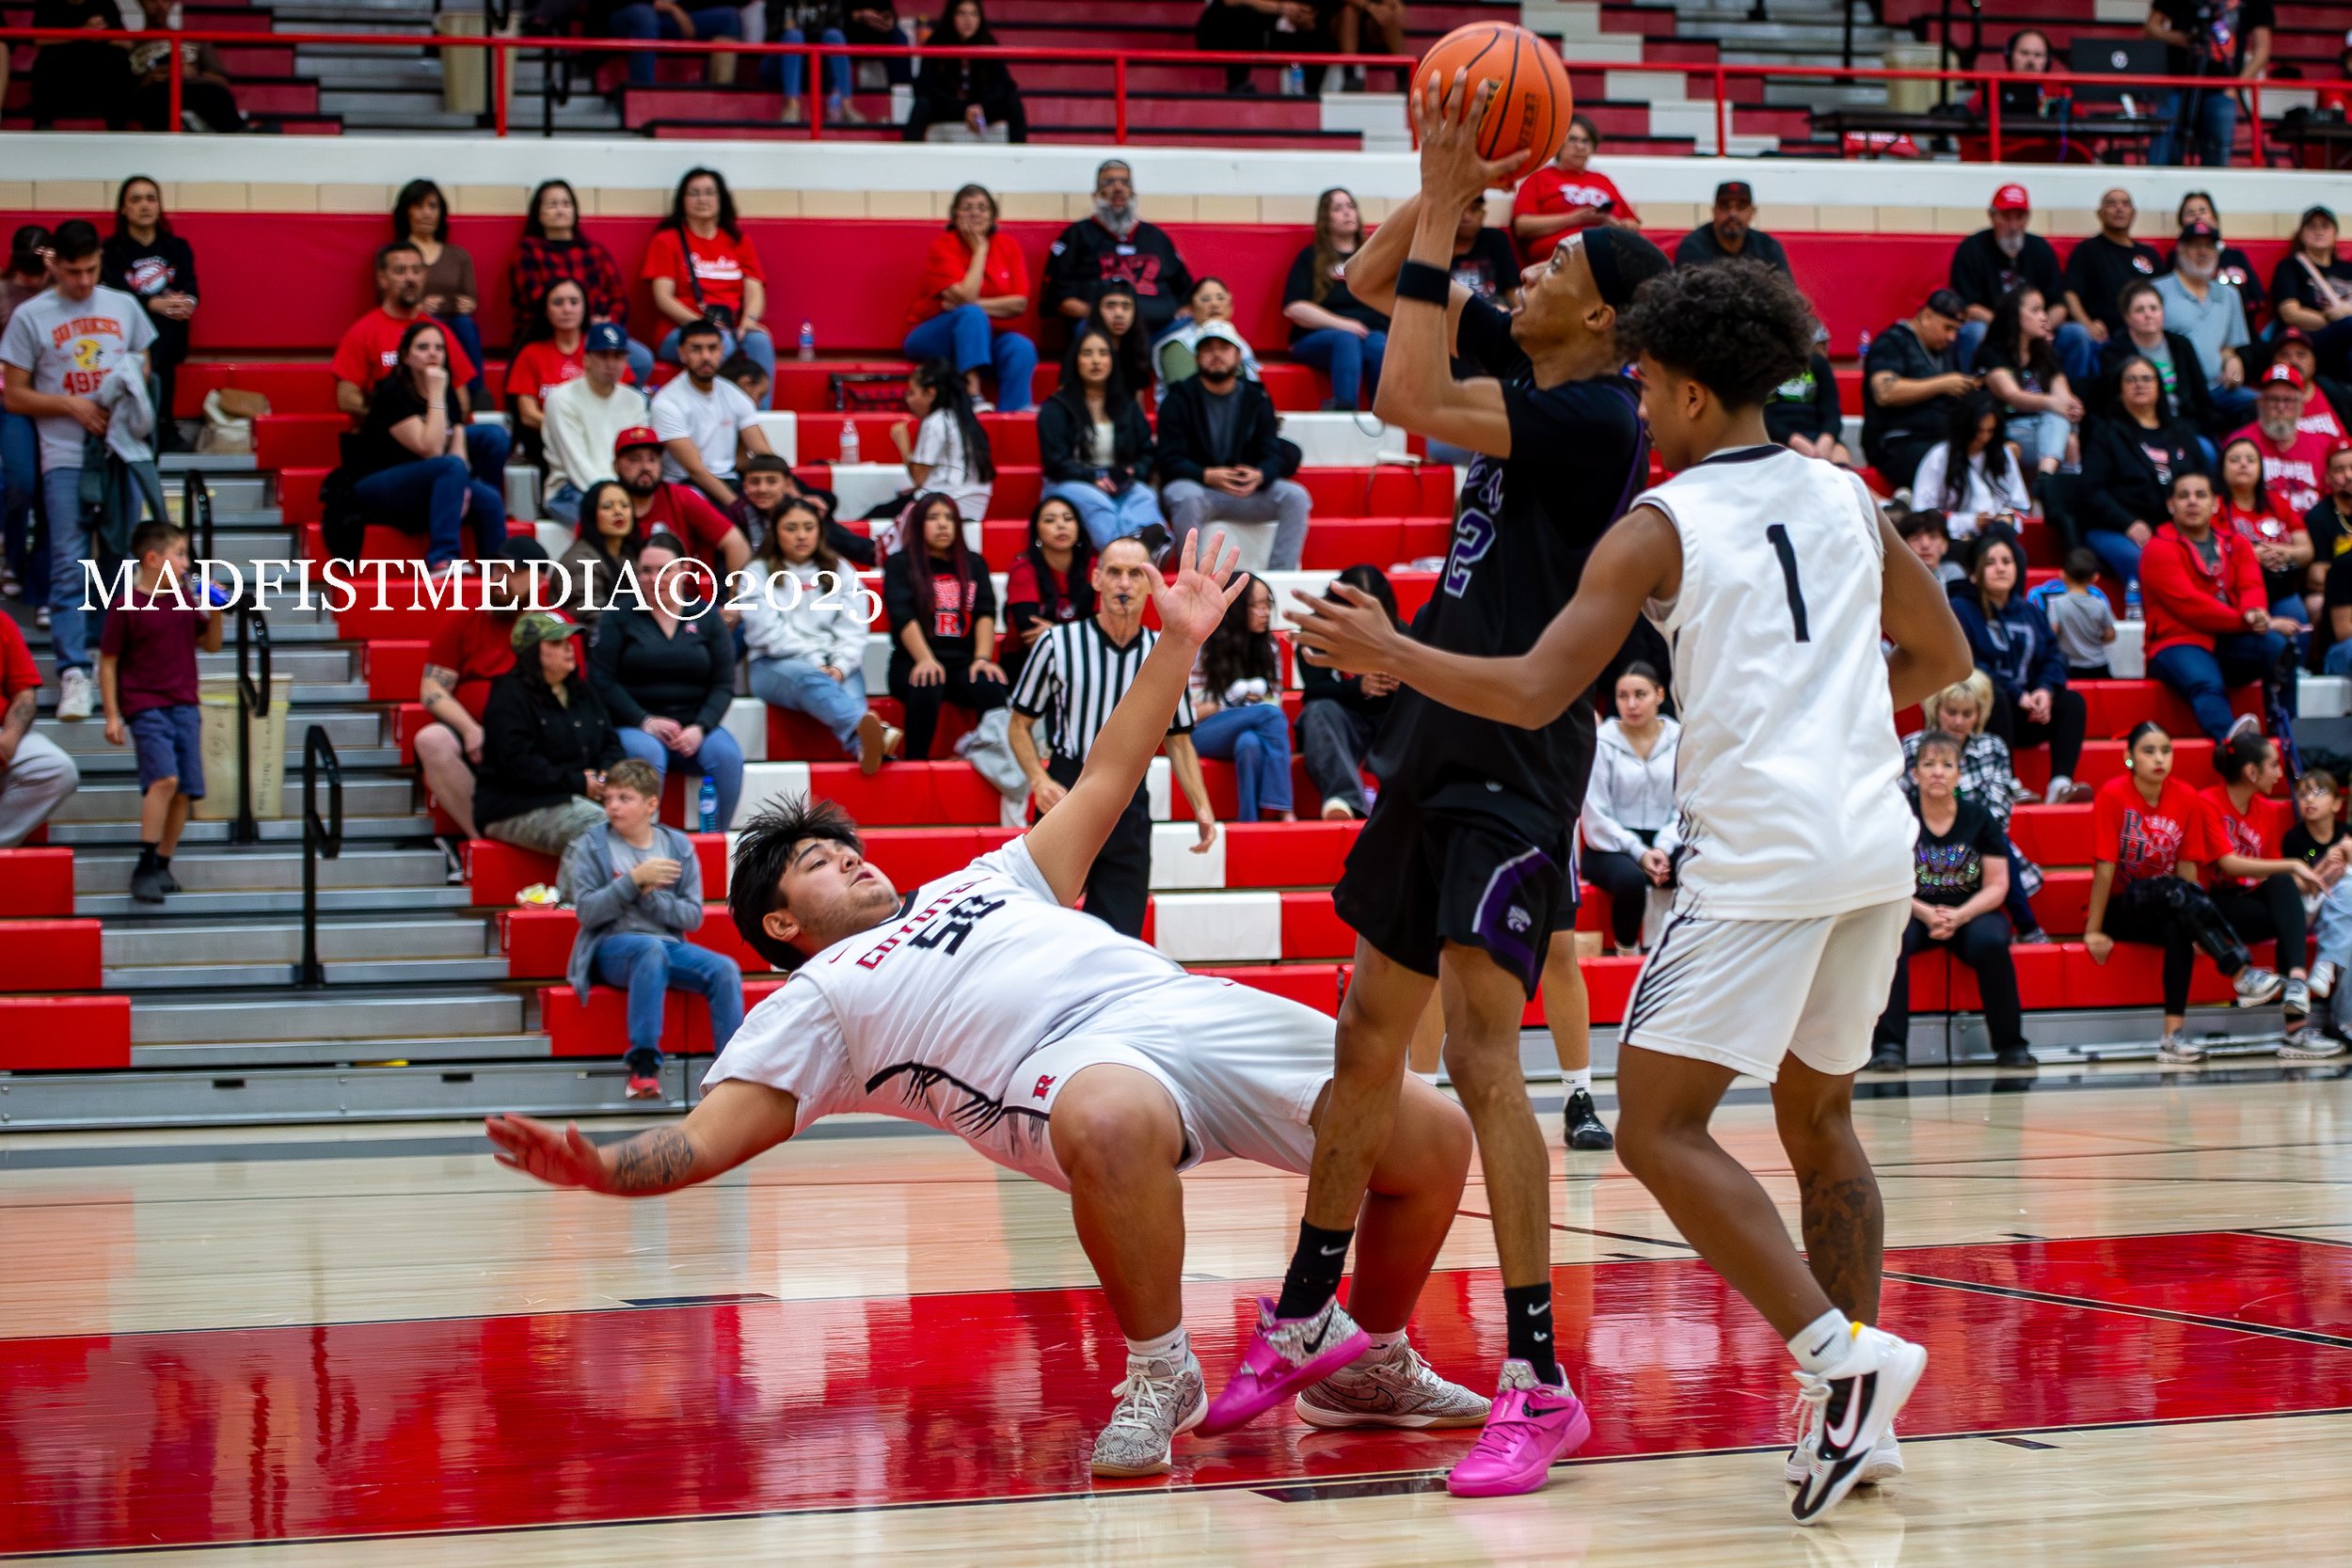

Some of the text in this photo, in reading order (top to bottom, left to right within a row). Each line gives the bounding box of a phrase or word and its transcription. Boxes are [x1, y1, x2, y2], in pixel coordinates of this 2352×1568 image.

[1766, 524, 1810, 643] 1
[935, 611, 961, 637] R
[1031, 1074, 1057, 1101] R
